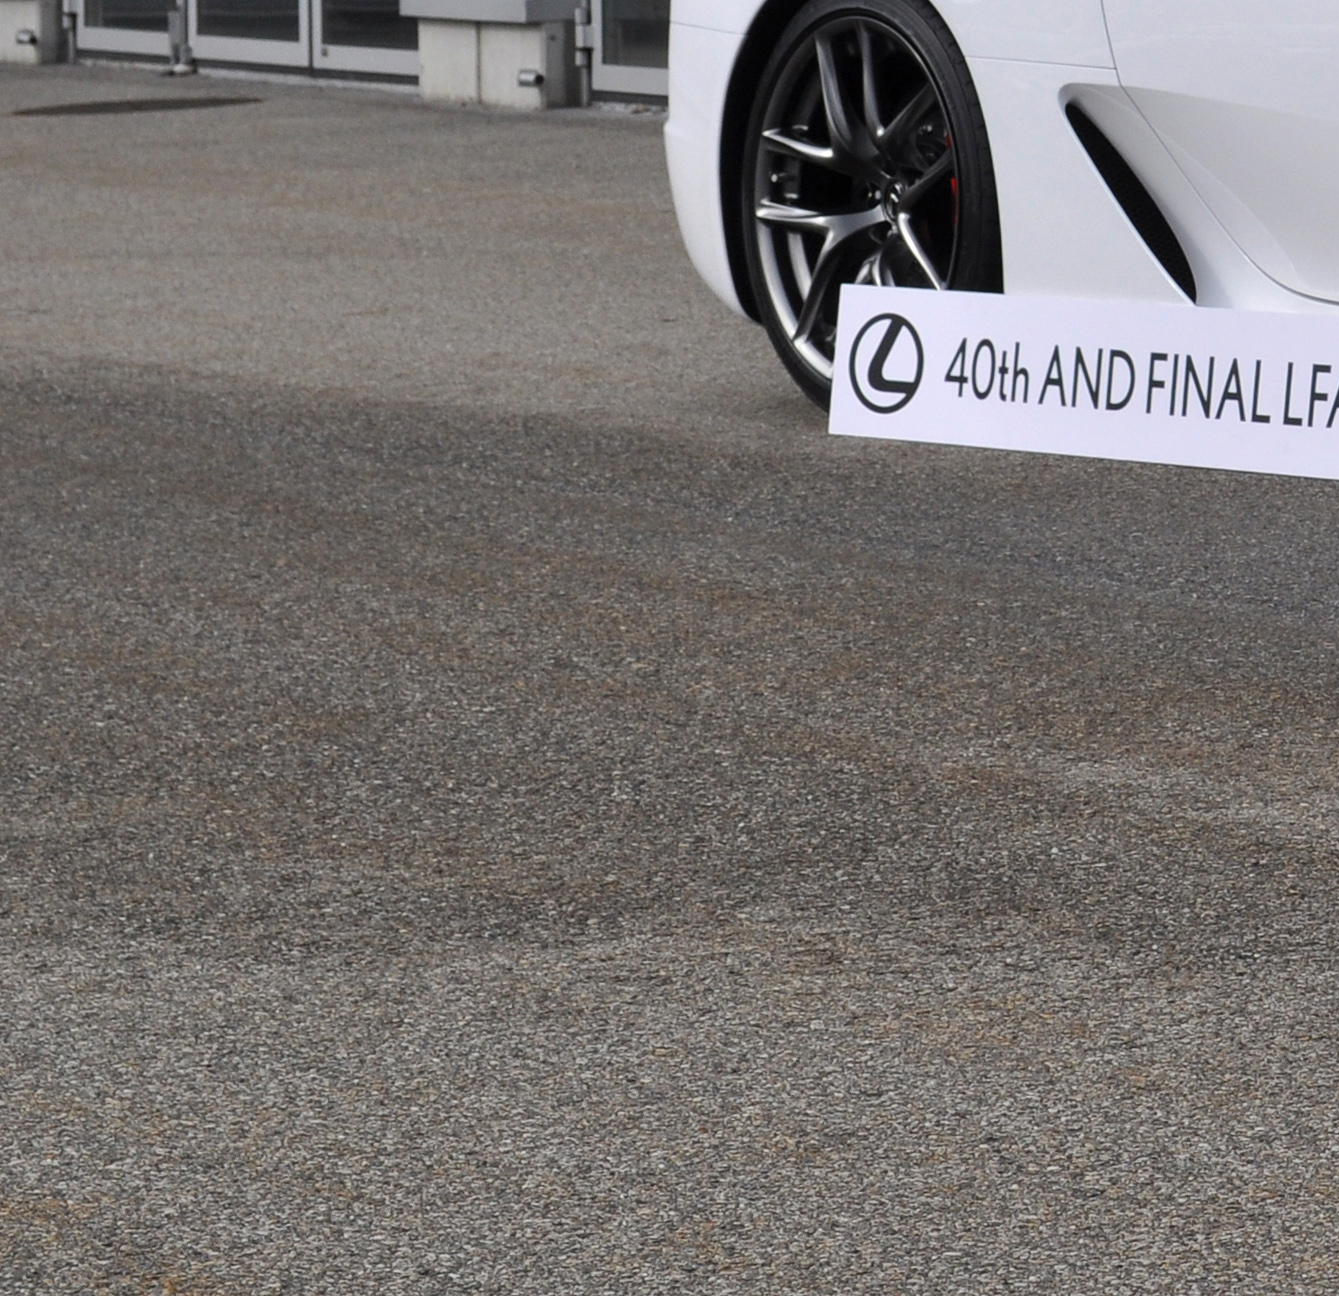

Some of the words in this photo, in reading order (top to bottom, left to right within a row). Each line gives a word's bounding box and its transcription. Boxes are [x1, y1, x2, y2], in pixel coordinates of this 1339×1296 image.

[944, 337, 1029, 403] 40th
[1038, 345, 1135, 411] AND
[1146, 352, 1271, 424] FINAL
